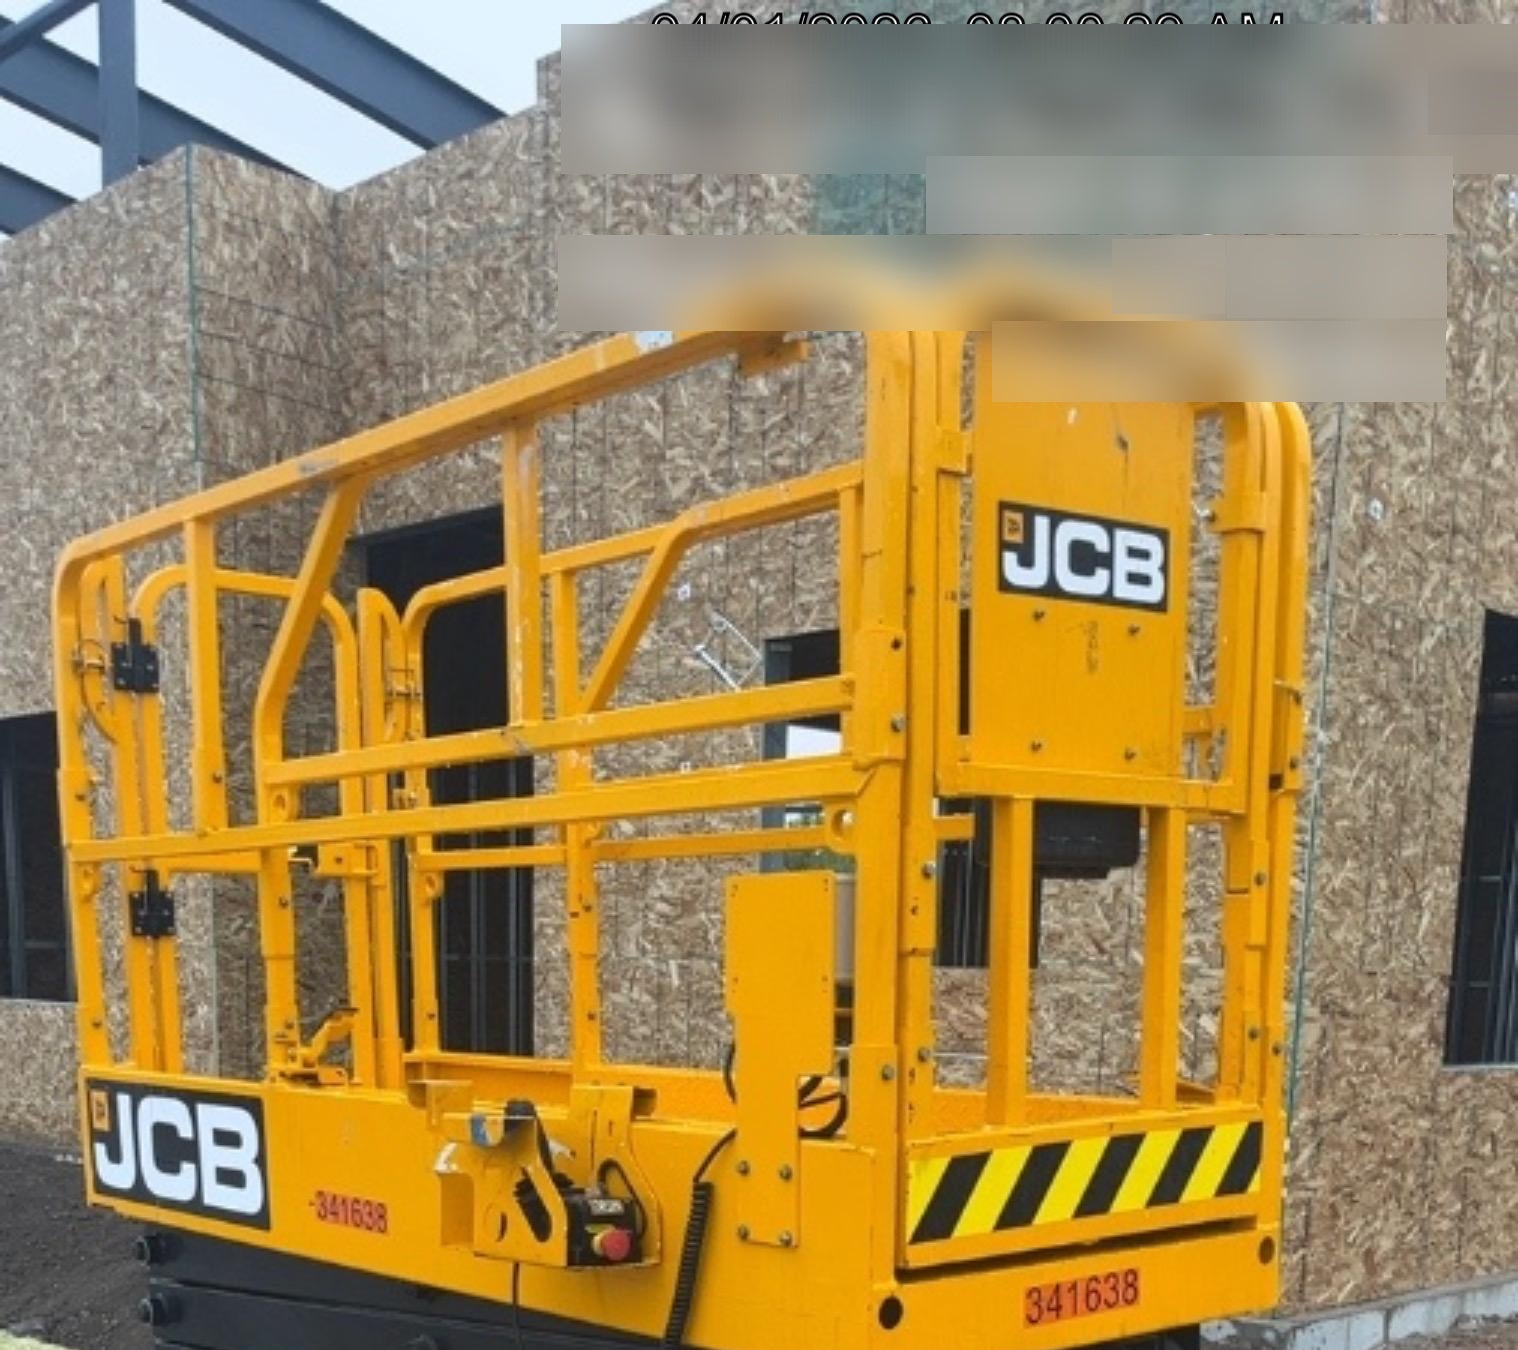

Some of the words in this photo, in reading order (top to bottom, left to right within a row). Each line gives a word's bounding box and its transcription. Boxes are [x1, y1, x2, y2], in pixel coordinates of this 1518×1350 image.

[1002, 514, 1166, 605] JCB
[93, 1091, 265, 1215] JCB
[316, 1189, 388, 1234] 341638
[1025, 1268, 1139, 1324] 341638
